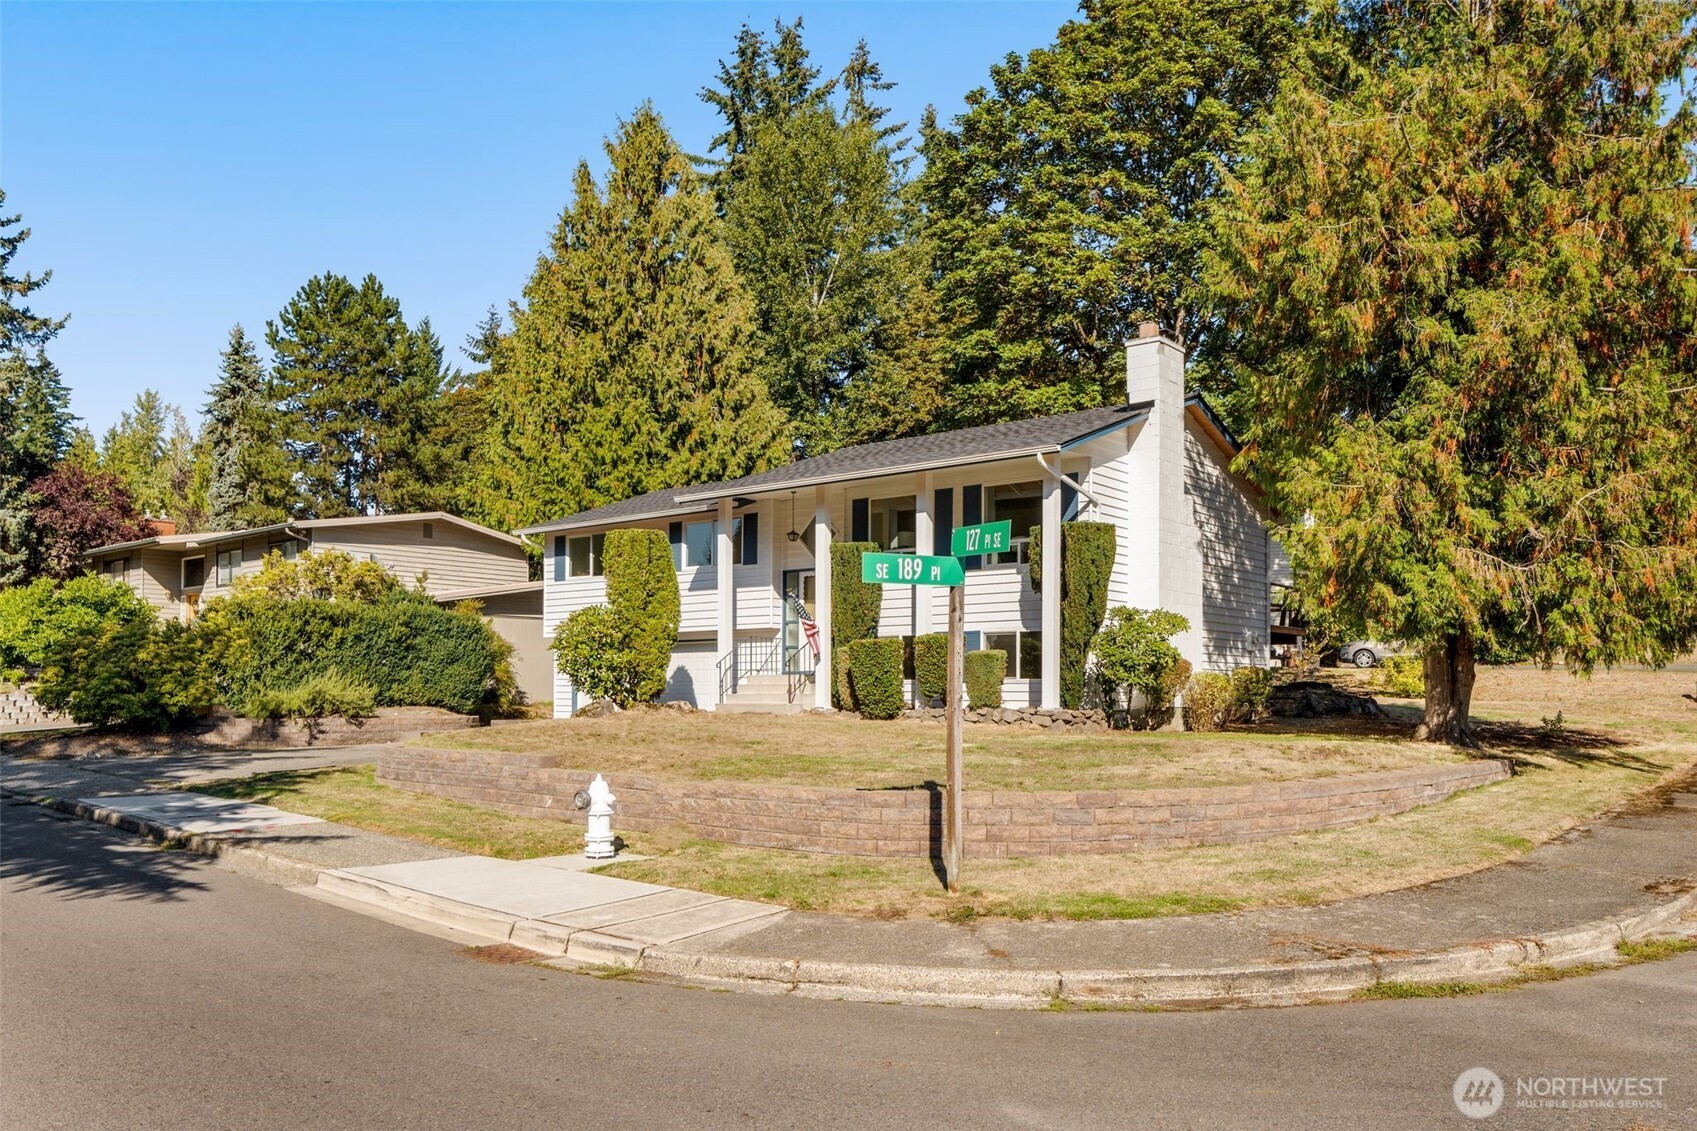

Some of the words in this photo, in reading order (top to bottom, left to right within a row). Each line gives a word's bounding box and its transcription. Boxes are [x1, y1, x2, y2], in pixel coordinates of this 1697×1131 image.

[966, 528, 980, 551] 127
[993, 532, 1002, 548] SE
[876, 564, 888, 579] SE
[898, 558, 922, 580] 189
